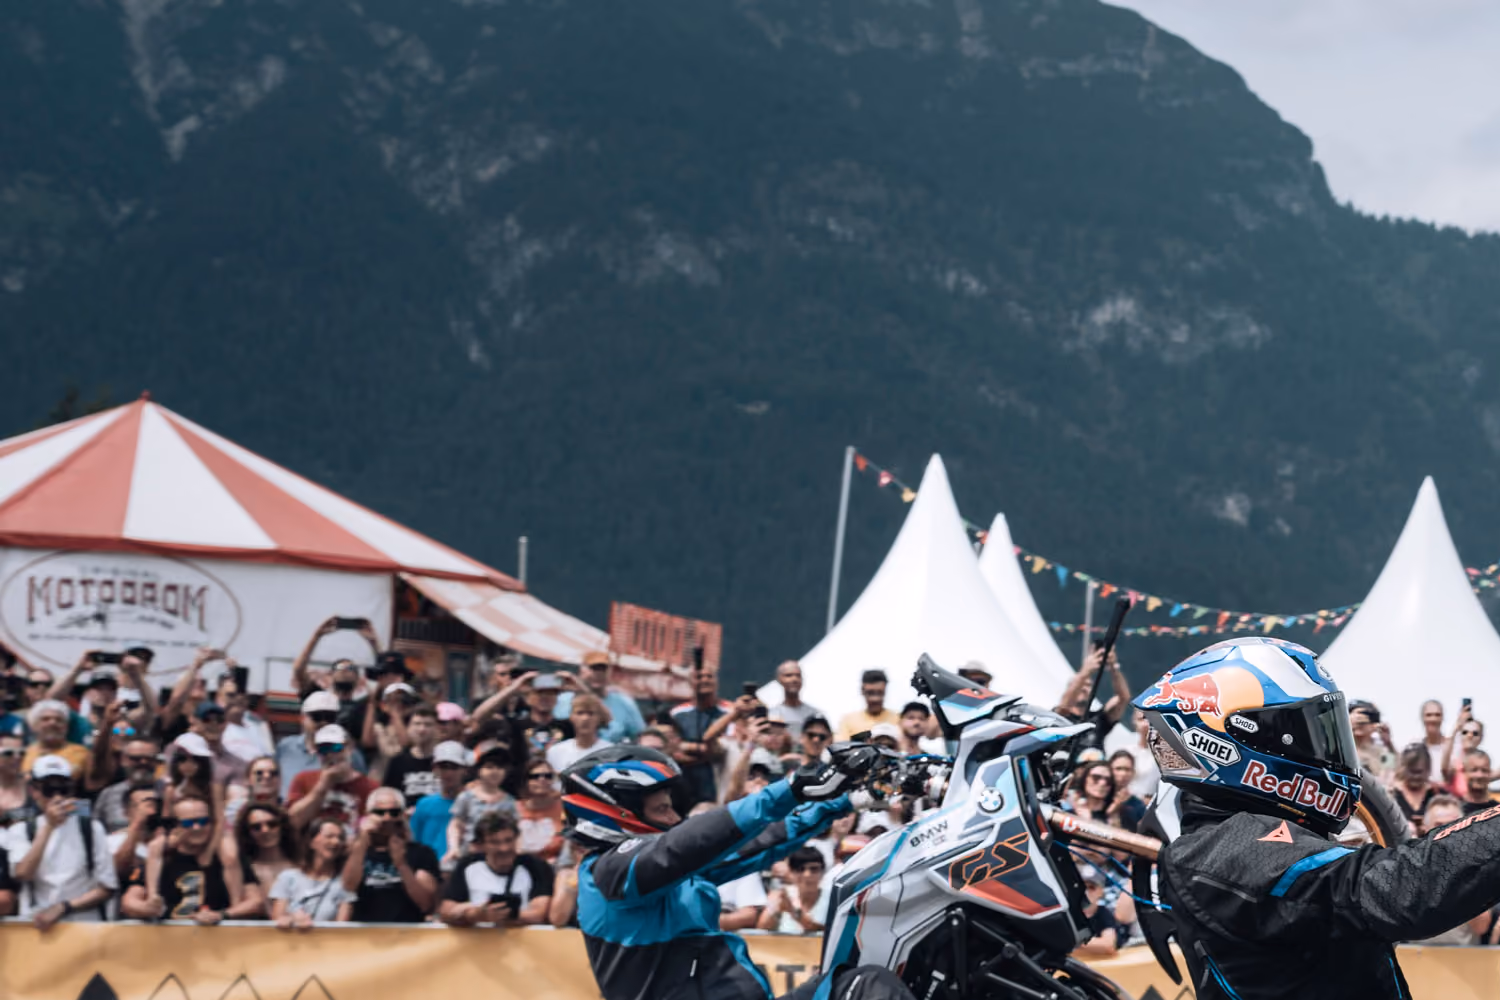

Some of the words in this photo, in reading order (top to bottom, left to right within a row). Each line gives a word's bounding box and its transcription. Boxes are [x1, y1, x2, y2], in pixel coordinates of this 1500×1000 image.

[27, 575, 209, 632] MOTODROM
[1235, 717, 1256, 731] SHOEI
[1188, 732, 1233, 763] SHOEI
[1241, 759, 1302, 800] Red
[1296, 777, 1348, 817] Bull
[910, 820, 948, 847] BMW
[948, 831, 1030, 891] GS
